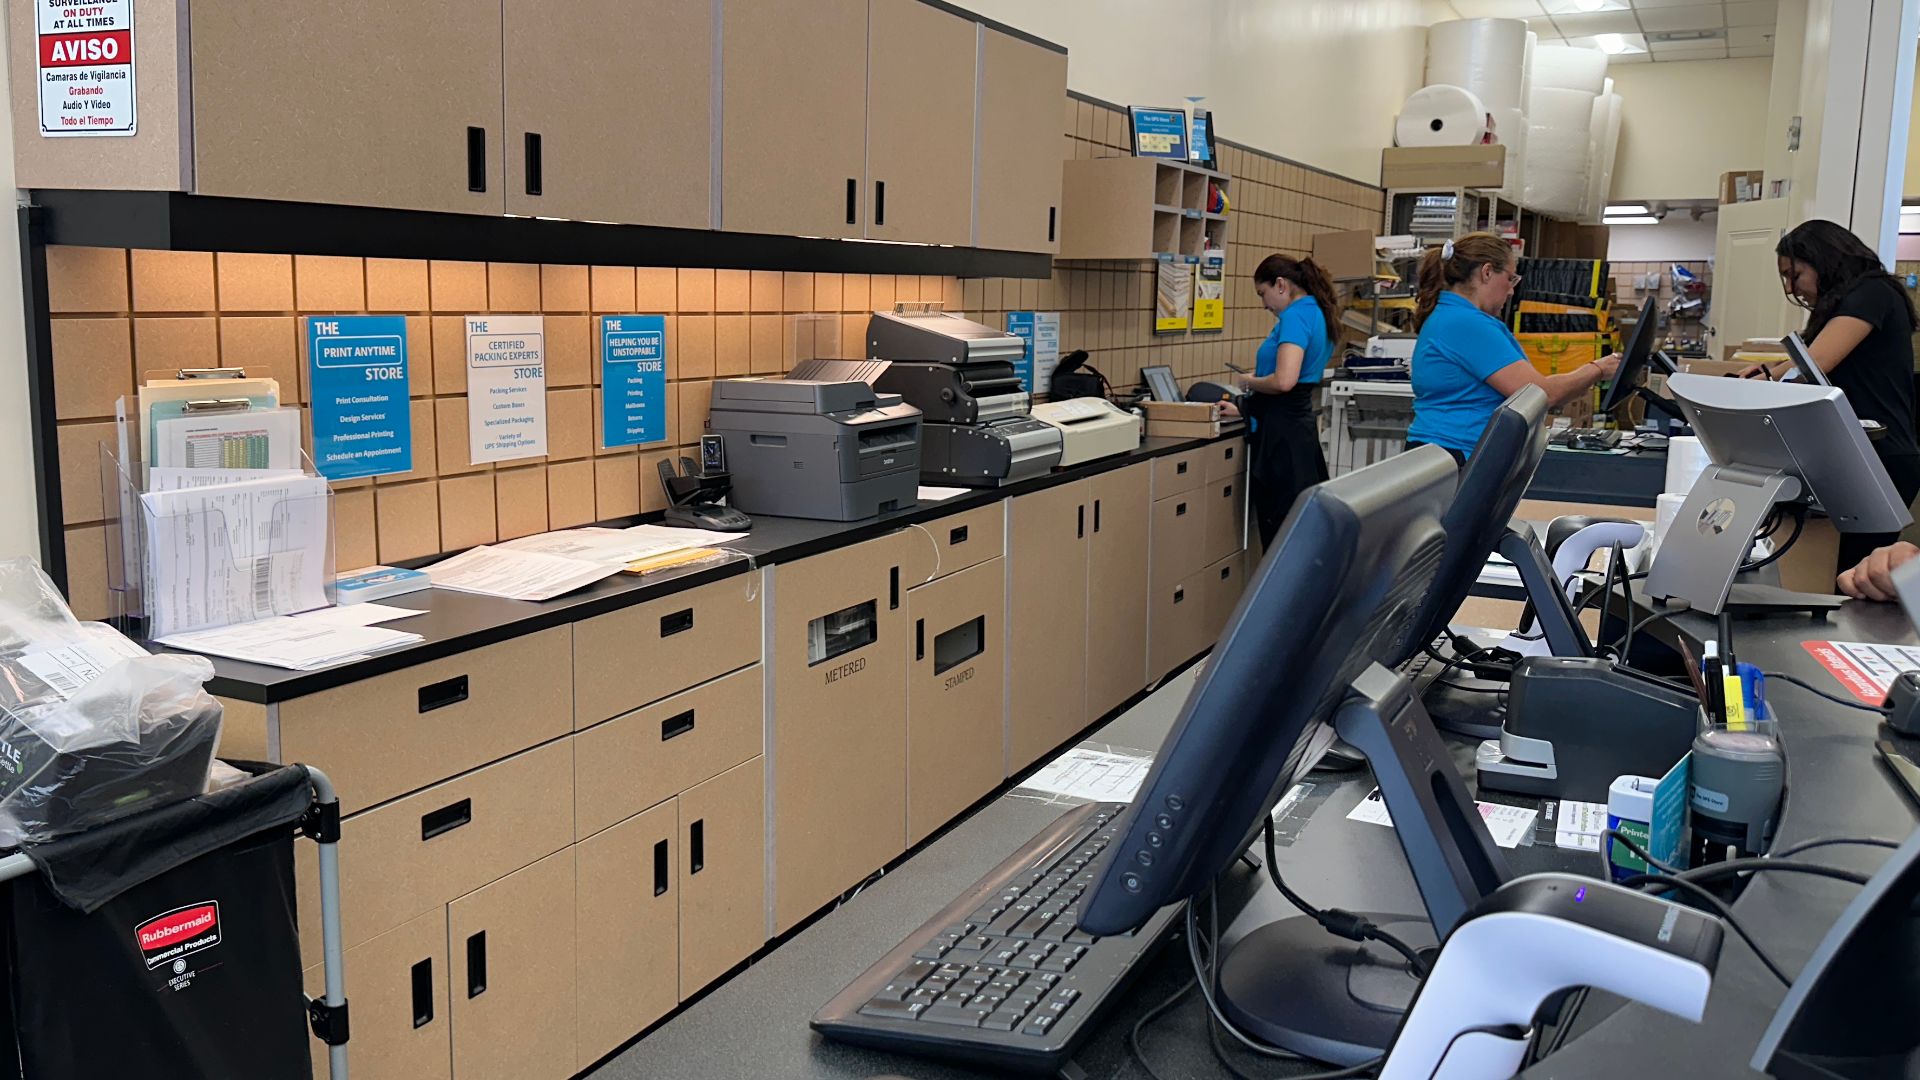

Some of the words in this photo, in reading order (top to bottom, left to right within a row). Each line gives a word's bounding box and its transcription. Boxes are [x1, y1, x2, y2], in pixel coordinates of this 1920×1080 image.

[63, 9, 76, 17] ON
[80, 7, 103, 16] DUTY
[54, 20, 64, 29] AT
[68, 19, 83, 28] ALL
[86, 17, 114, 27] TIMES
[51, 37, 118, 62] AVISO
[46, 73, 78, 82] Camaras
[90, 70, 126, 82] Vigilancia
[69, 86, 103, 96] Grabando
[63, 100, 82, 110] Audio
[84, 100, 89, 109] Y
[90, 100, 111, 109] Video
[61, 117, 78, 126] Todo
[80, 116, 86, 125] el
[88, 116, 113, 126] Tiempo
[314, 322, 339, 335] THE
[469, 322, 488, 332] THE
[606, 320, 622, 330] THE
[488, 340, 525, 350] CERTIFIED
[609, 338, 636, 347] HELPING
[324, 347, 352, 358] PRINT
[354, 346, 396, 356] ANYTIME
[475, 352, 507, 361] PACKING
[509, 351, 538, 360] EXPERTS
[613, 347, 656, 357] UNSTOPPABLE
[637, 361, 662, 372] STORE
[366, 367, 404, 380] STORE
[514, 367, 543, 379] STORE
[352, 395, 388, 403] Consultation
[340, 415, 360, 423] Design
[484, 418, 510, 427] Specialized
[333, 432, 370, 442] Professional
[326, 452, 354, 461] Schedule
[364, 447, 402, 458] Appointment
[825, 658, 866, 685] METERED
[944, 667, 975, 690] STAMPED
[142, 912, 211, 943] Rubbermaid
[184, 934, 217, 950] Products
[168, 970, 195, 986] EXECUTIVE
[174, 980, 190, 991] SERIES
